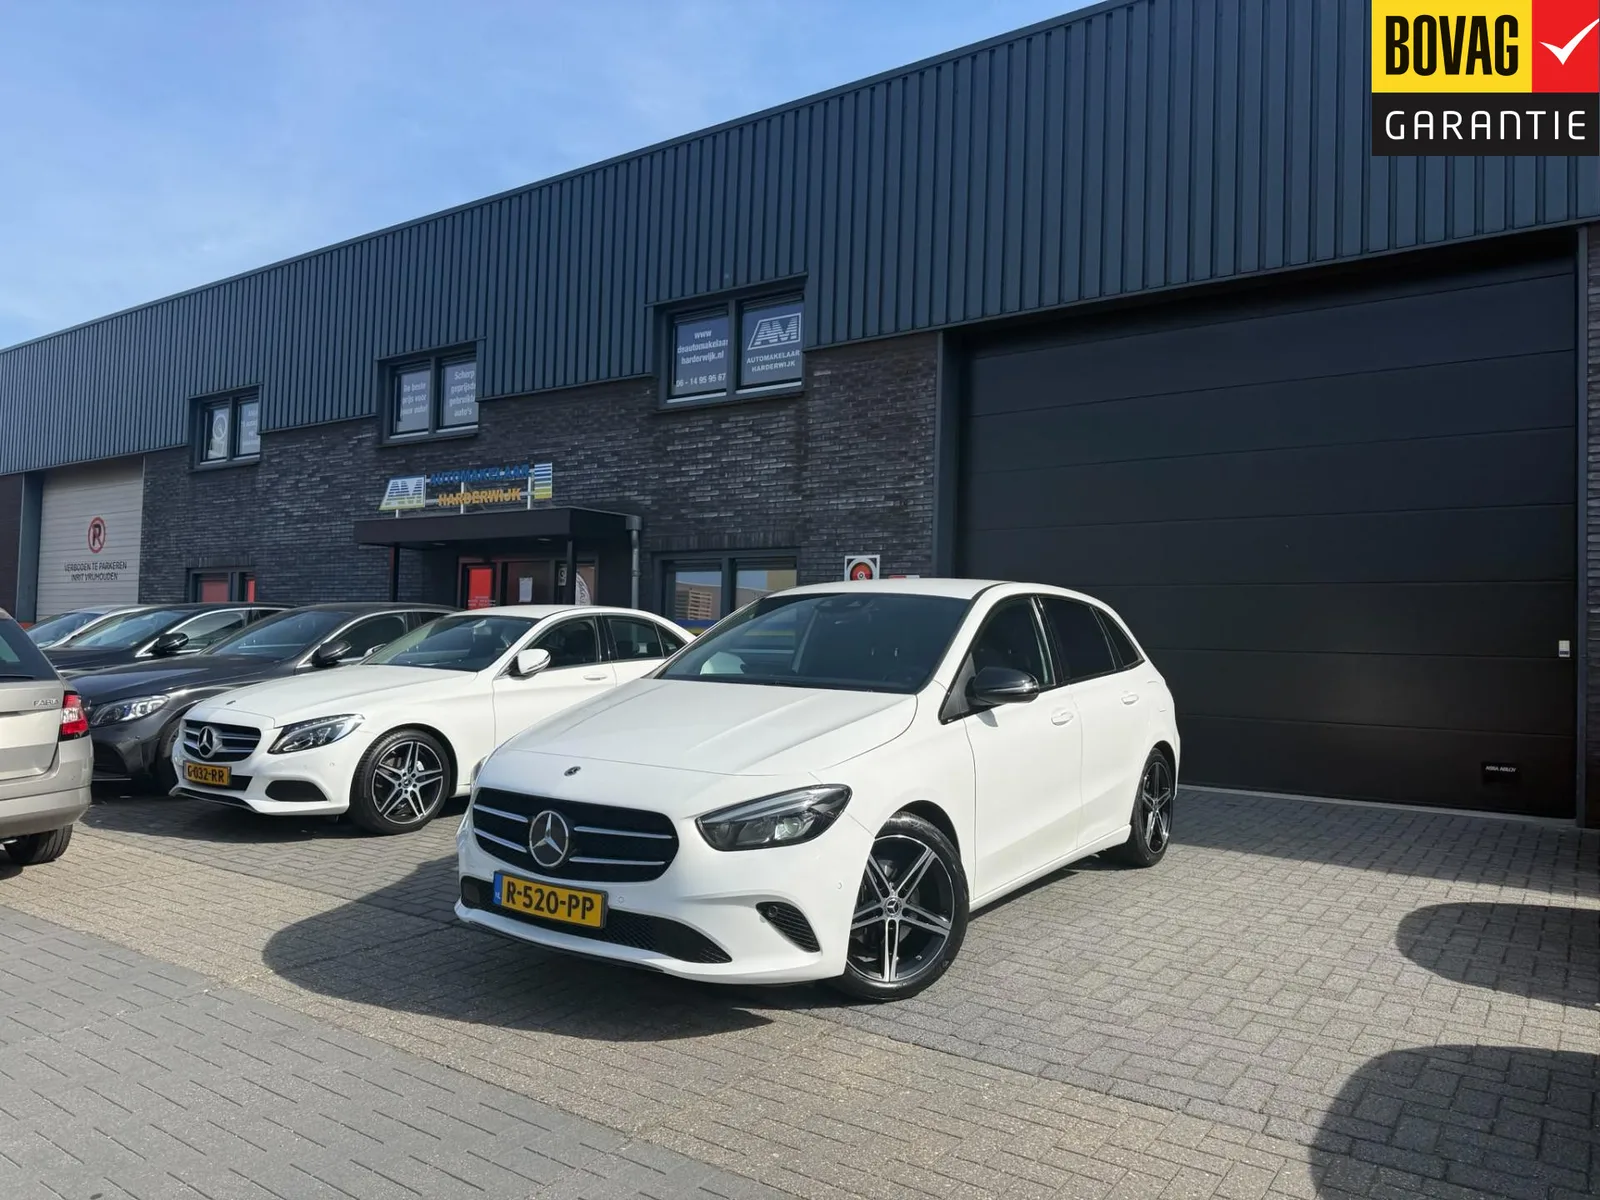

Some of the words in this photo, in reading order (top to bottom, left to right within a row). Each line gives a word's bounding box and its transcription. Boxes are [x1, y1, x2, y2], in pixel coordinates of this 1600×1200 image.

[694, 330, 712, 339] www
[681, 350, 725, 365] harderwijk.nl
[746, 350, 800, 364] AUTOMAKELAAR
[751, 361, 796, 373] HARDERWIJK
[690, 377, 698, 385] 14
[429, 464, 530, 486] AUTOMAKELAAR
[438, 487, 521, 507] HARDERWIJK
[92, 562, 98, 570] TE
[99, 561, 127, 570] PARKEREN
[506, 880, 595, 920] R-520-PP
